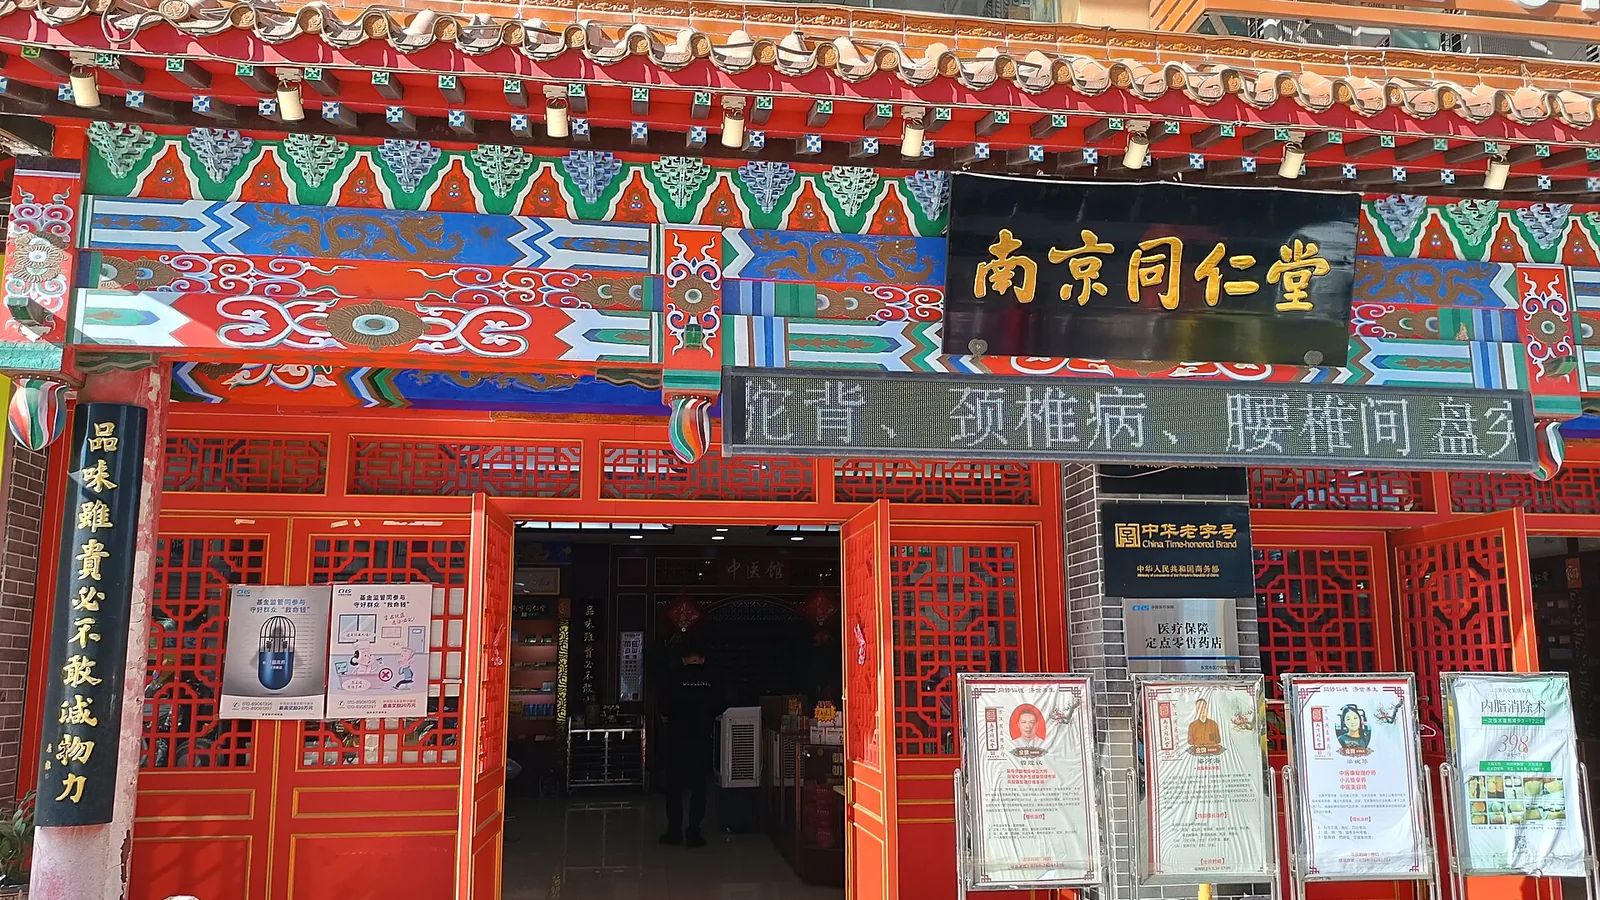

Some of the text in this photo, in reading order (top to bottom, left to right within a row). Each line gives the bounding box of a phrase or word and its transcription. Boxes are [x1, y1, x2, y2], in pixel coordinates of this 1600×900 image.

[973, 228, 1331, 312] 南京同仁堂
[1141, 523, 1237, 540] 中华老字号
[1142, 540, 1237, 549] China Time-honored Brand
[726, 559, 784, 581] 中医馆
[1136, 564, 1220, 573] 中华人民共和国商务部
[1158, 622, 1209, 635] 医疗保障
[1145, 637, 1222, 649] 定点零售药店
[1481, 699, 1546, 713] 内脂消除术
[1497, 734, 1529, 752] 398
